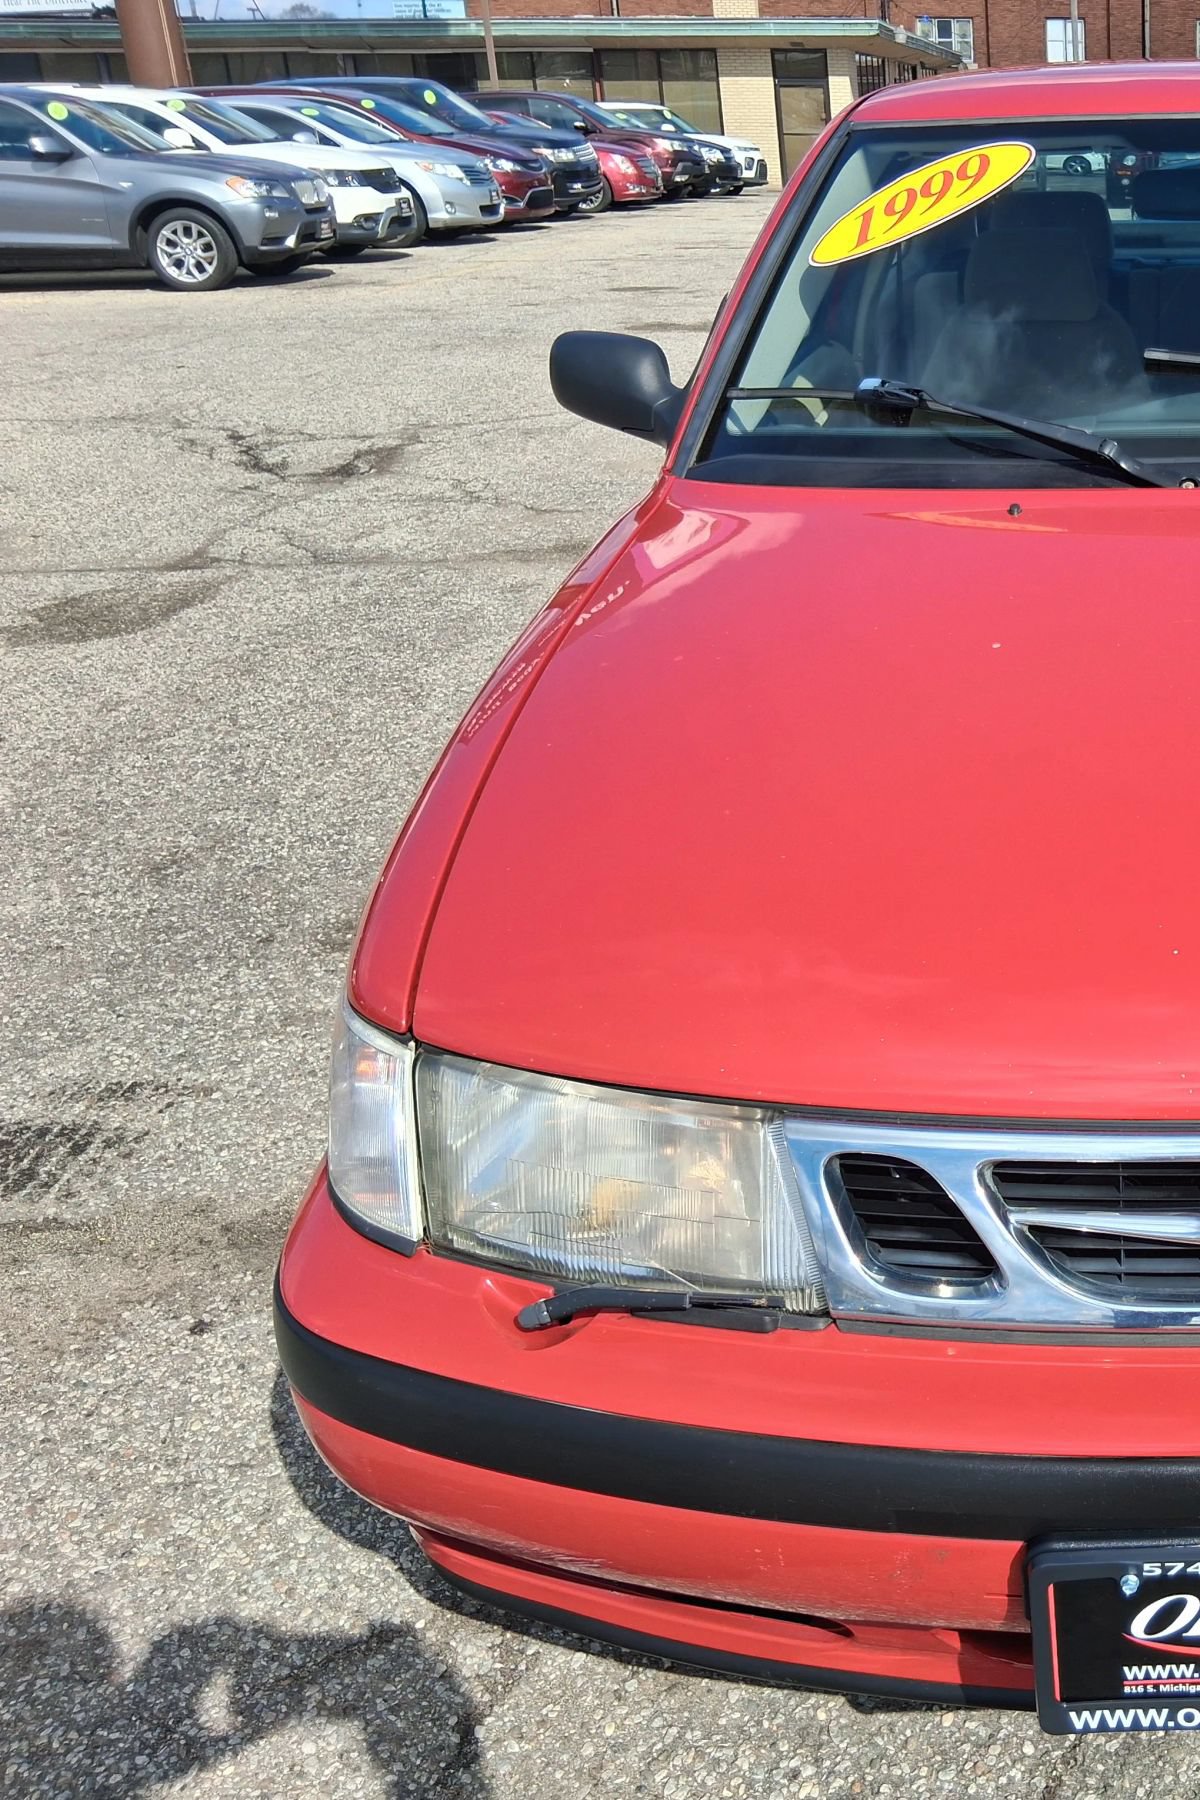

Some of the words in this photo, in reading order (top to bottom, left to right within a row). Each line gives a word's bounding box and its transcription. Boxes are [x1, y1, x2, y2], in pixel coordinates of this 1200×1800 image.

[848, 153, 990, 252] 1999
[1124, 1685, 1144, 1693] 816
[1146, 1685, 1157, 1693] S.
